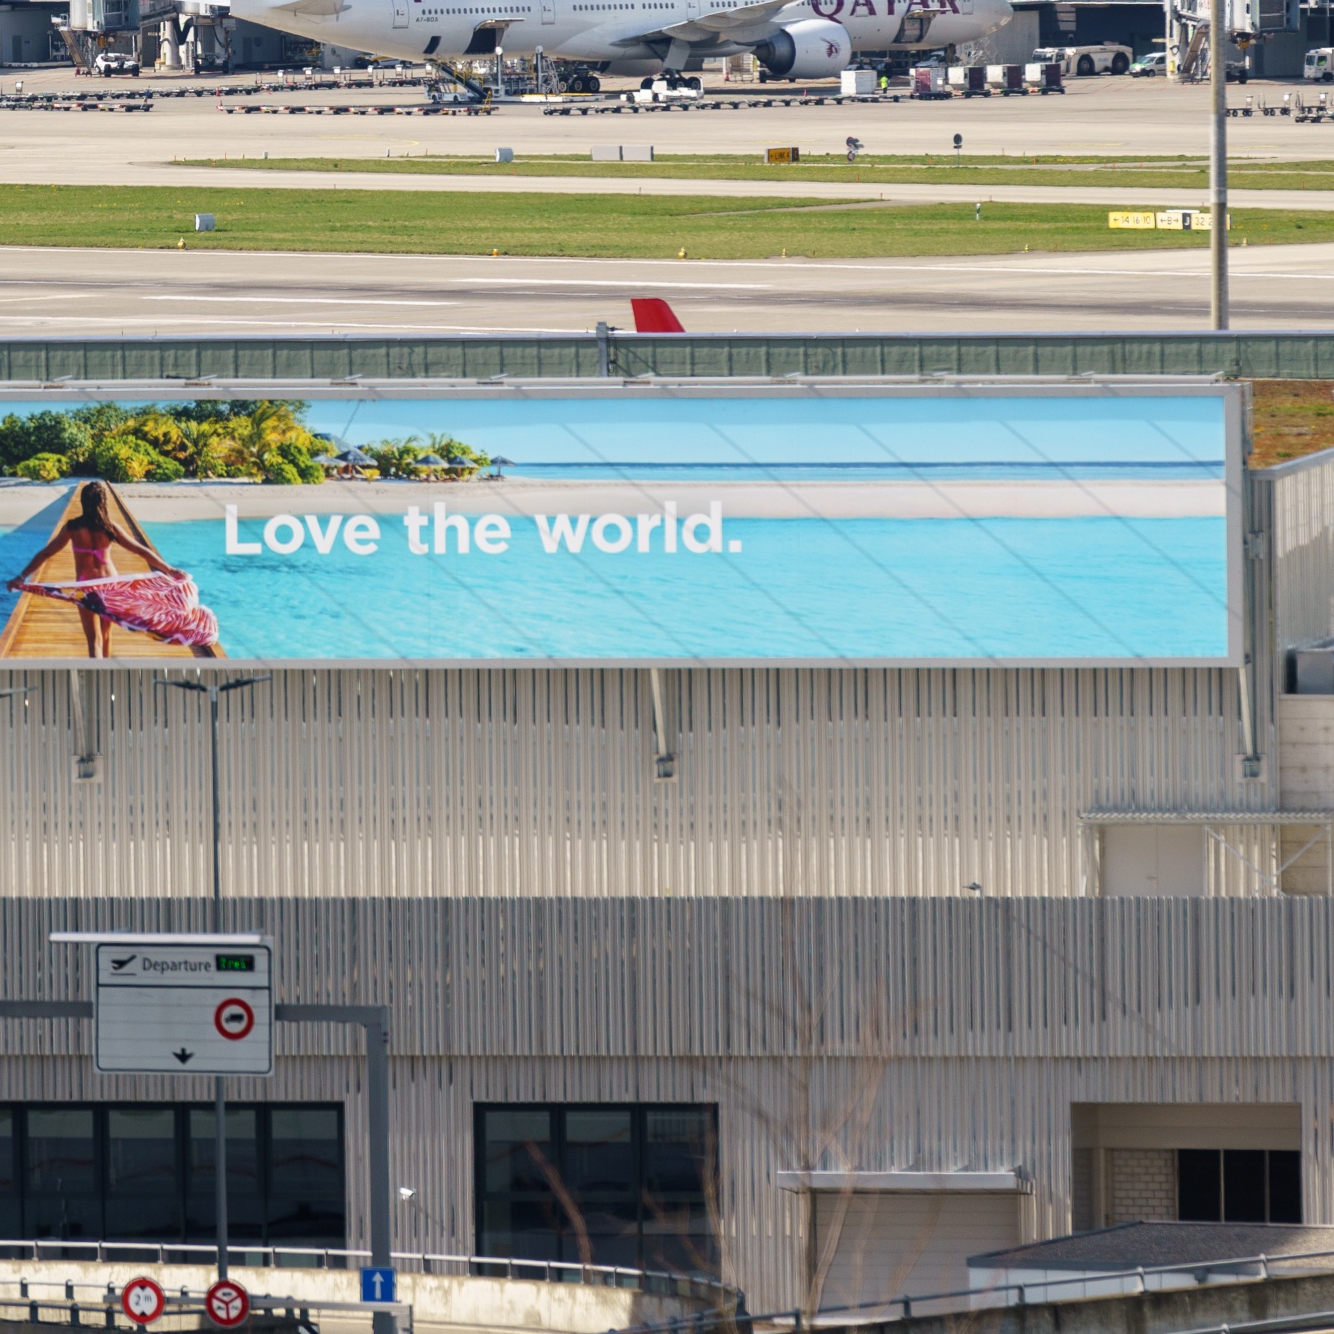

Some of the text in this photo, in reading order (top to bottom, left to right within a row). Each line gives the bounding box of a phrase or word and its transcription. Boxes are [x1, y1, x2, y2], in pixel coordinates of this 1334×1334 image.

[224, 500, 743, 556] Love the world.
[142, 956, 212, 974] Departure
